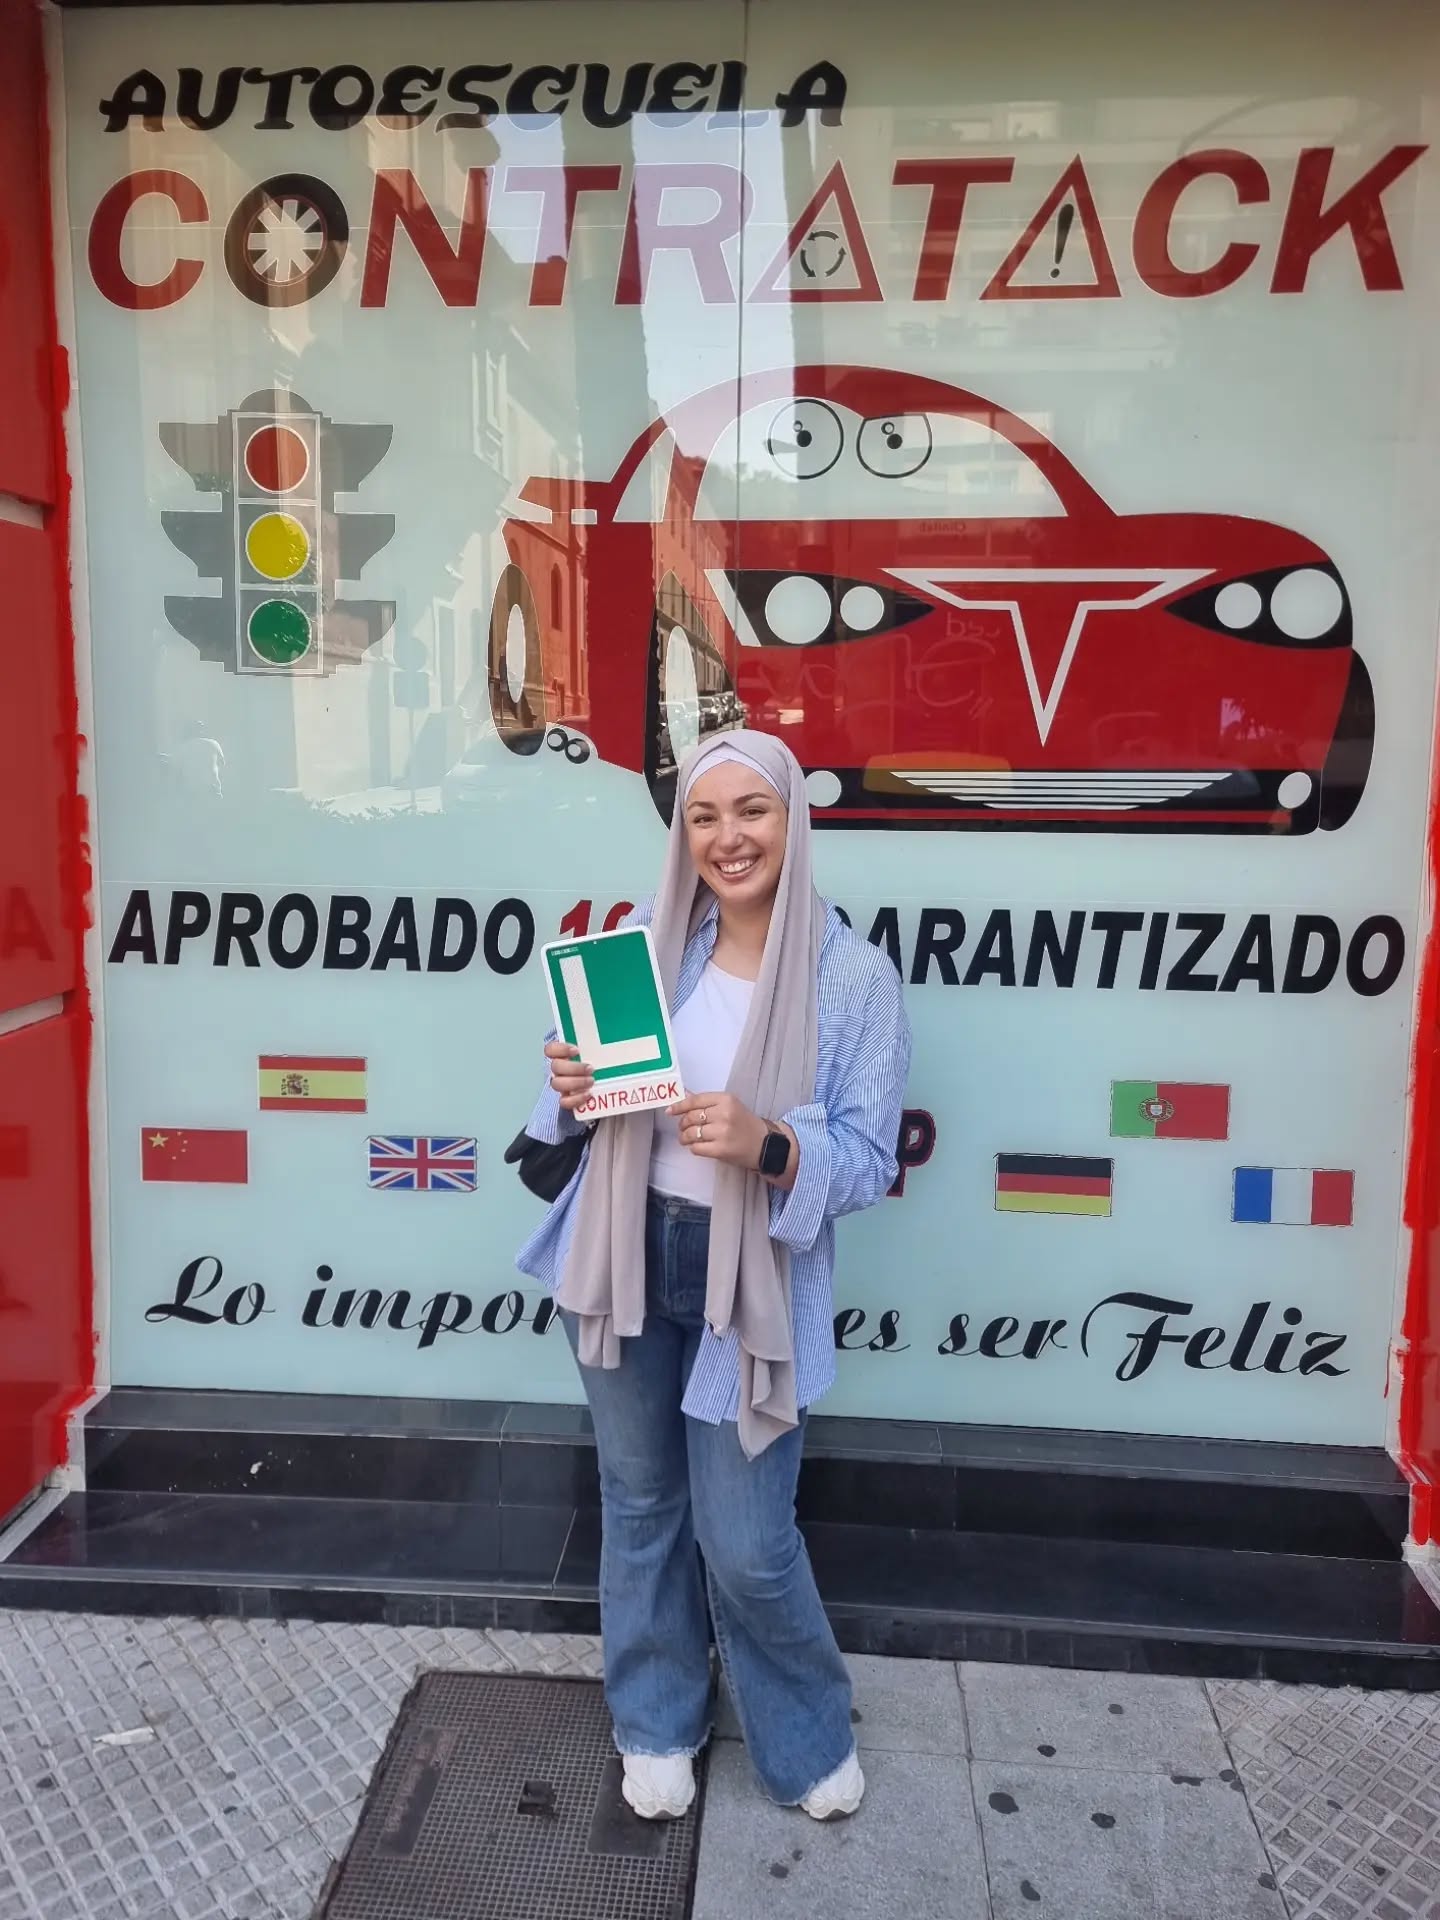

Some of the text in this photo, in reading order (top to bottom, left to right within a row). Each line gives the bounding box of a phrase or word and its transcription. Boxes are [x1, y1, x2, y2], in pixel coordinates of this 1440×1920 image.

[99, 60, 848, 133] AUTOESCUELA
[108, 889, 536, 975] APROBADO
[834, 905, 1406, 997] ARANTIZADO
[144, 1255, 1351, 1382] Lo impor es ser Feliz
